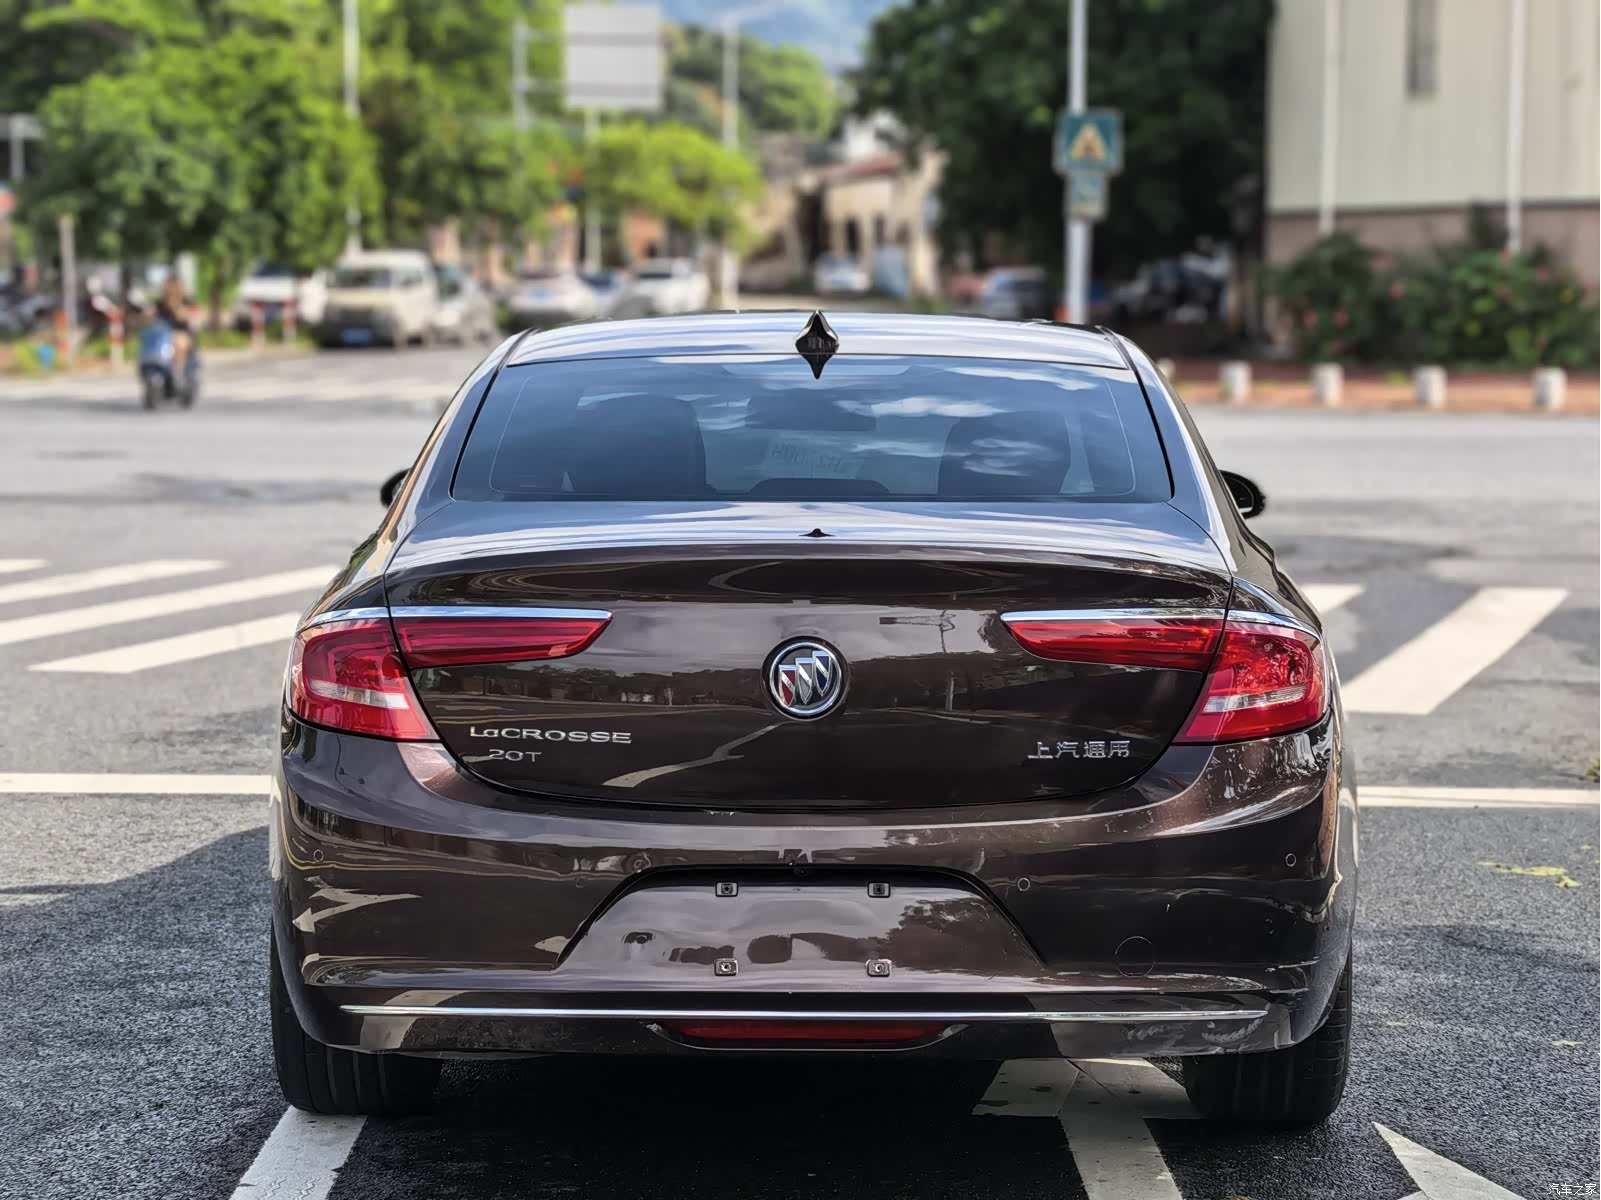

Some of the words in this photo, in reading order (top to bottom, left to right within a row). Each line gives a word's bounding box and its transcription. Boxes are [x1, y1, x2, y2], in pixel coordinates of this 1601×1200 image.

[469, 726, 633, 744] LaCROSSE
[488, 749, 543, 763] 20T
[1027, 740, 1131, 759] 上汽通用
